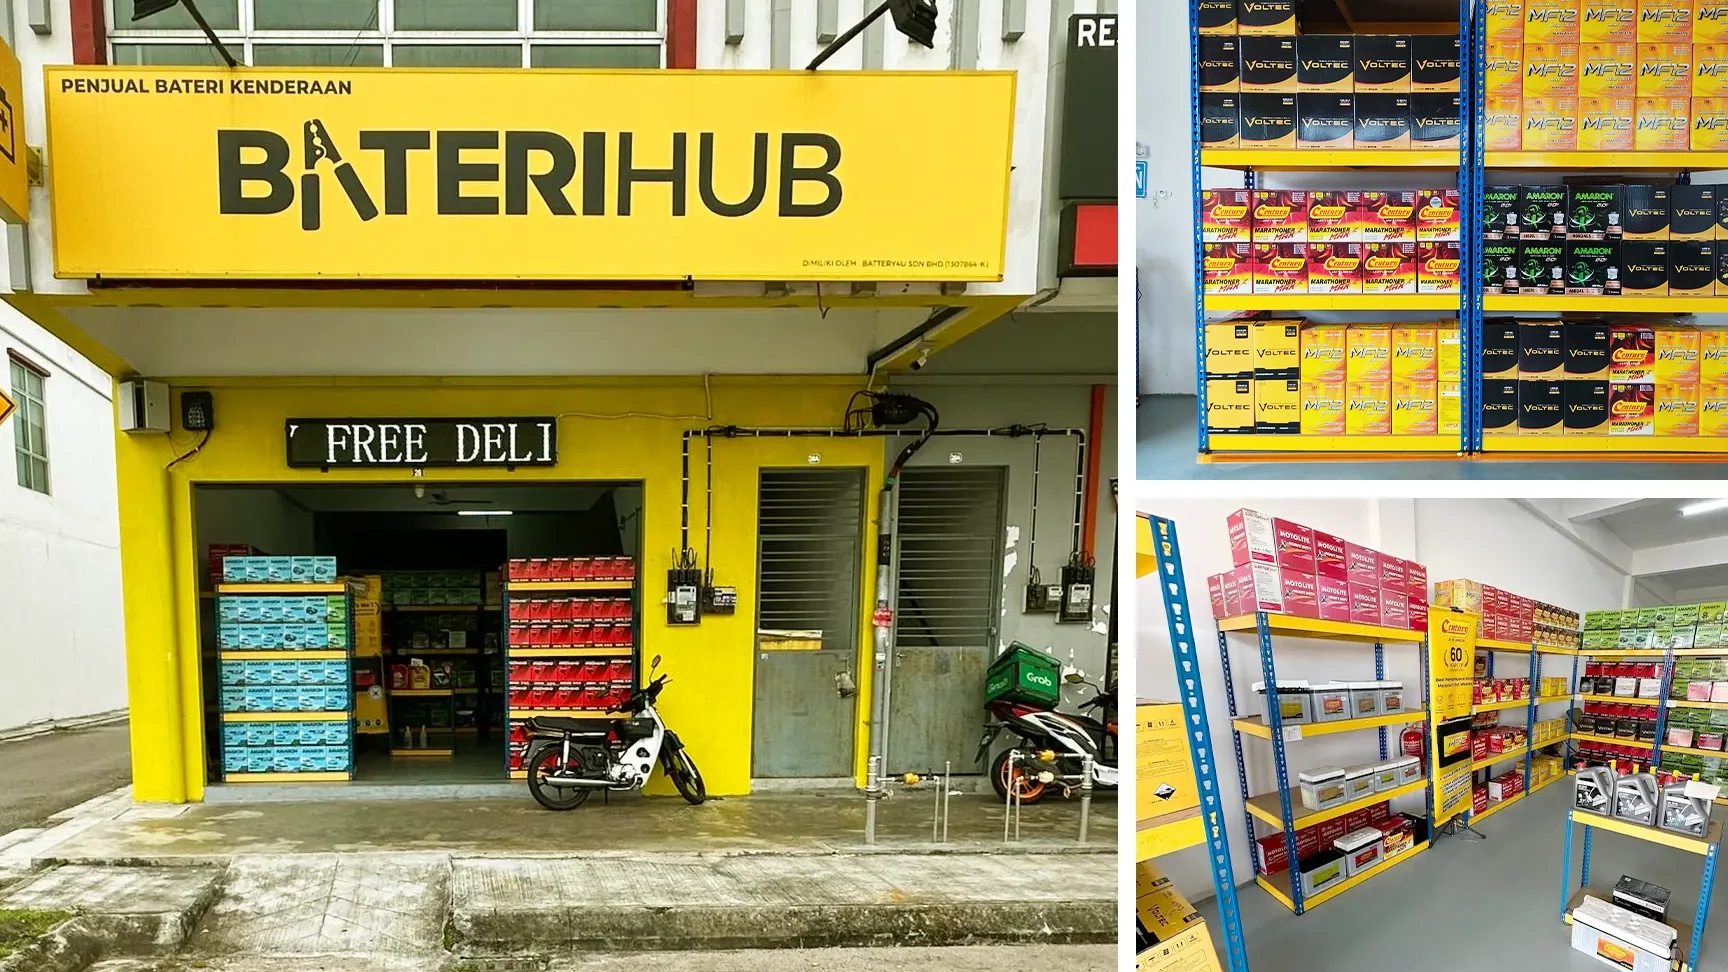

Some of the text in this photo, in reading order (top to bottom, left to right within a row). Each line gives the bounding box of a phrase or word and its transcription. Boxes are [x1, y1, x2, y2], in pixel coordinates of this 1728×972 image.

[1244, 2, 1290, 13] VOLTEC
[1077, 18, 1118, 47] RE
[1245, 60, 1293, 71] VOLTEC
[1301, 60, 1349, 71] VOLTEC
[1360, 60, 1406, 71] VOLTEC
[61, 79, 351, 95] PENJUAL BATERI KENDERAAN
[1244, 117, 1291, 128] VOLTEC
[1301, 118, 1349, 129] VOLTEC
[1358, 118, 1405, 128] VOLTEC
[1484, 193, 1516, 201] MARON
[1526, 192, 1563, 200] AMARON
[1575, 192, 1613, 201] AMARON
[1212, 206, 1244, 216] Century
[1255, 206, 1288, 216] Century
[1311, 206, 1343, 216] Century
[1379, 206, 1411, 216] Century
[1420, 207, 1451, 217] Century
[1629, 209, 1665, 217] VOLTEC
[1676, 209, 1711, 217] VOLTEC
[1525, 247, 1562, 255] AMARON
[1574, 247, 1612, 255] AMARON
[836, 260, 857, 268] OLEH
[862, 260, 907, 268] BATTERY4U
[908, 260, 925, 268] SDN
[926, 260, 944, 268] BHD
[1271, 258, 1303, 268] Century
[1326, 258, 1358, 268] Century
[1367, 258, 1398, 268] Century
[1427, 258, 1458, 269] Century
[1627, 265, 1664, 273] VOLTEC
[1675, 265, 1711, 273] VOLTEC
[1257, 349, 1296, 358] VOLTEC
[1524, 348, 1560, 356] VOLTEC
[1569, 349, 1605, 358] VOLTEC
[1614, 350, 1646, 359] Century
[1259, 403, 1296, 411] VOLTEC
[1524, 404, 1560, 412] VOLTEC
[1569, 404, 1604, 412] VOLTEC
[1613, 402, 1645, 411] Century
[326, 423, 552, 463] FREE DELI
[1280, 530, 1311, 543] MOTOLITE
[1317, 542, 1343, 554] MOTOLITE
[1285, 580, 1314, 590] MOTOLITE
[1322, 587, 1346, 596] MOTOLITE
[1441, 619, 1468, 634] Century
[1450, 647, 1463, 662] 60
[1026, 672, 1052, 687] Grab
